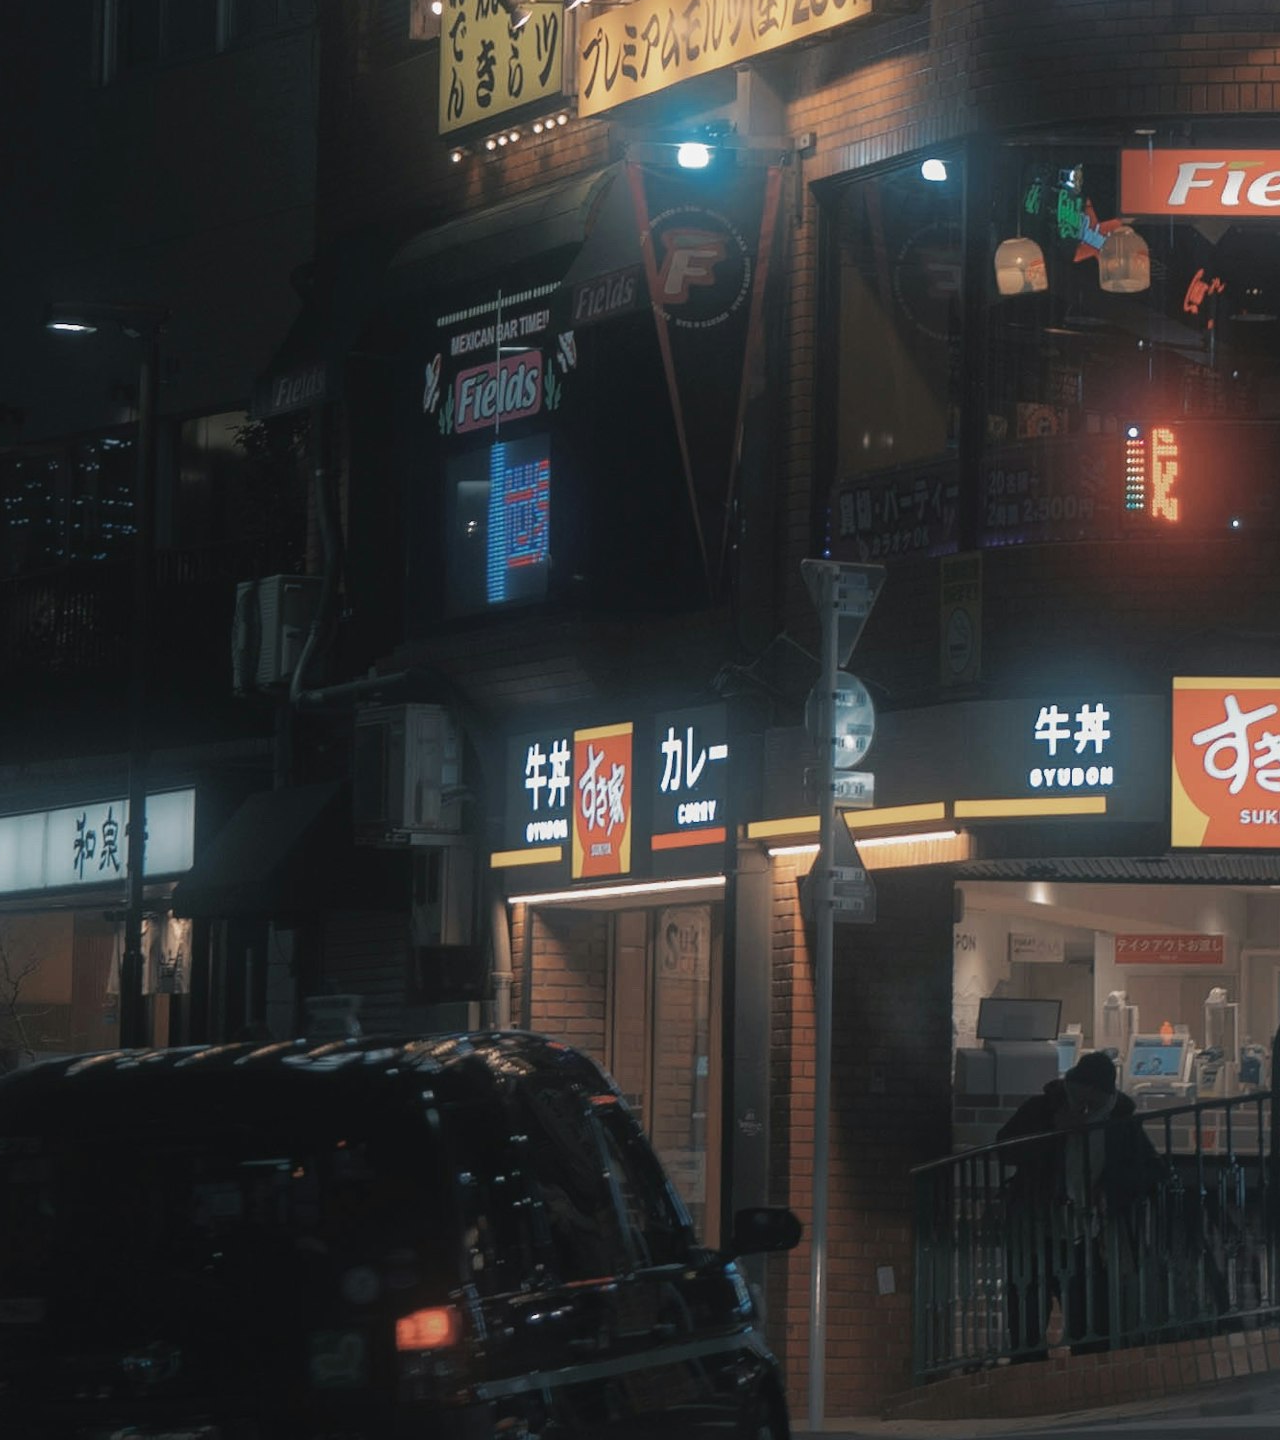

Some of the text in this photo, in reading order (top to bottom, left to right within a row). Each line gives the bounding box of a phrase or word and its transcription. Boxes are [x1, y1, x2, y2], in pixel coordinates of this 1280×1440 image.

[575, 273, 636, 321] Fields
[451, 323, 497, 357] MEXICAN
[497, 319, 519, 342] BAR
[456, 363, 540, 426] Fields
[1034, 702, 1111, 756] 牛丼
[524, 738, 571, 811] 牛丼
[660, 726, 729, 793] カレー
[1029, 766, 1115, 789] GYUDON
[578, 743, 626, 837] すき家
[677, 799, 717, 825] CURRY
